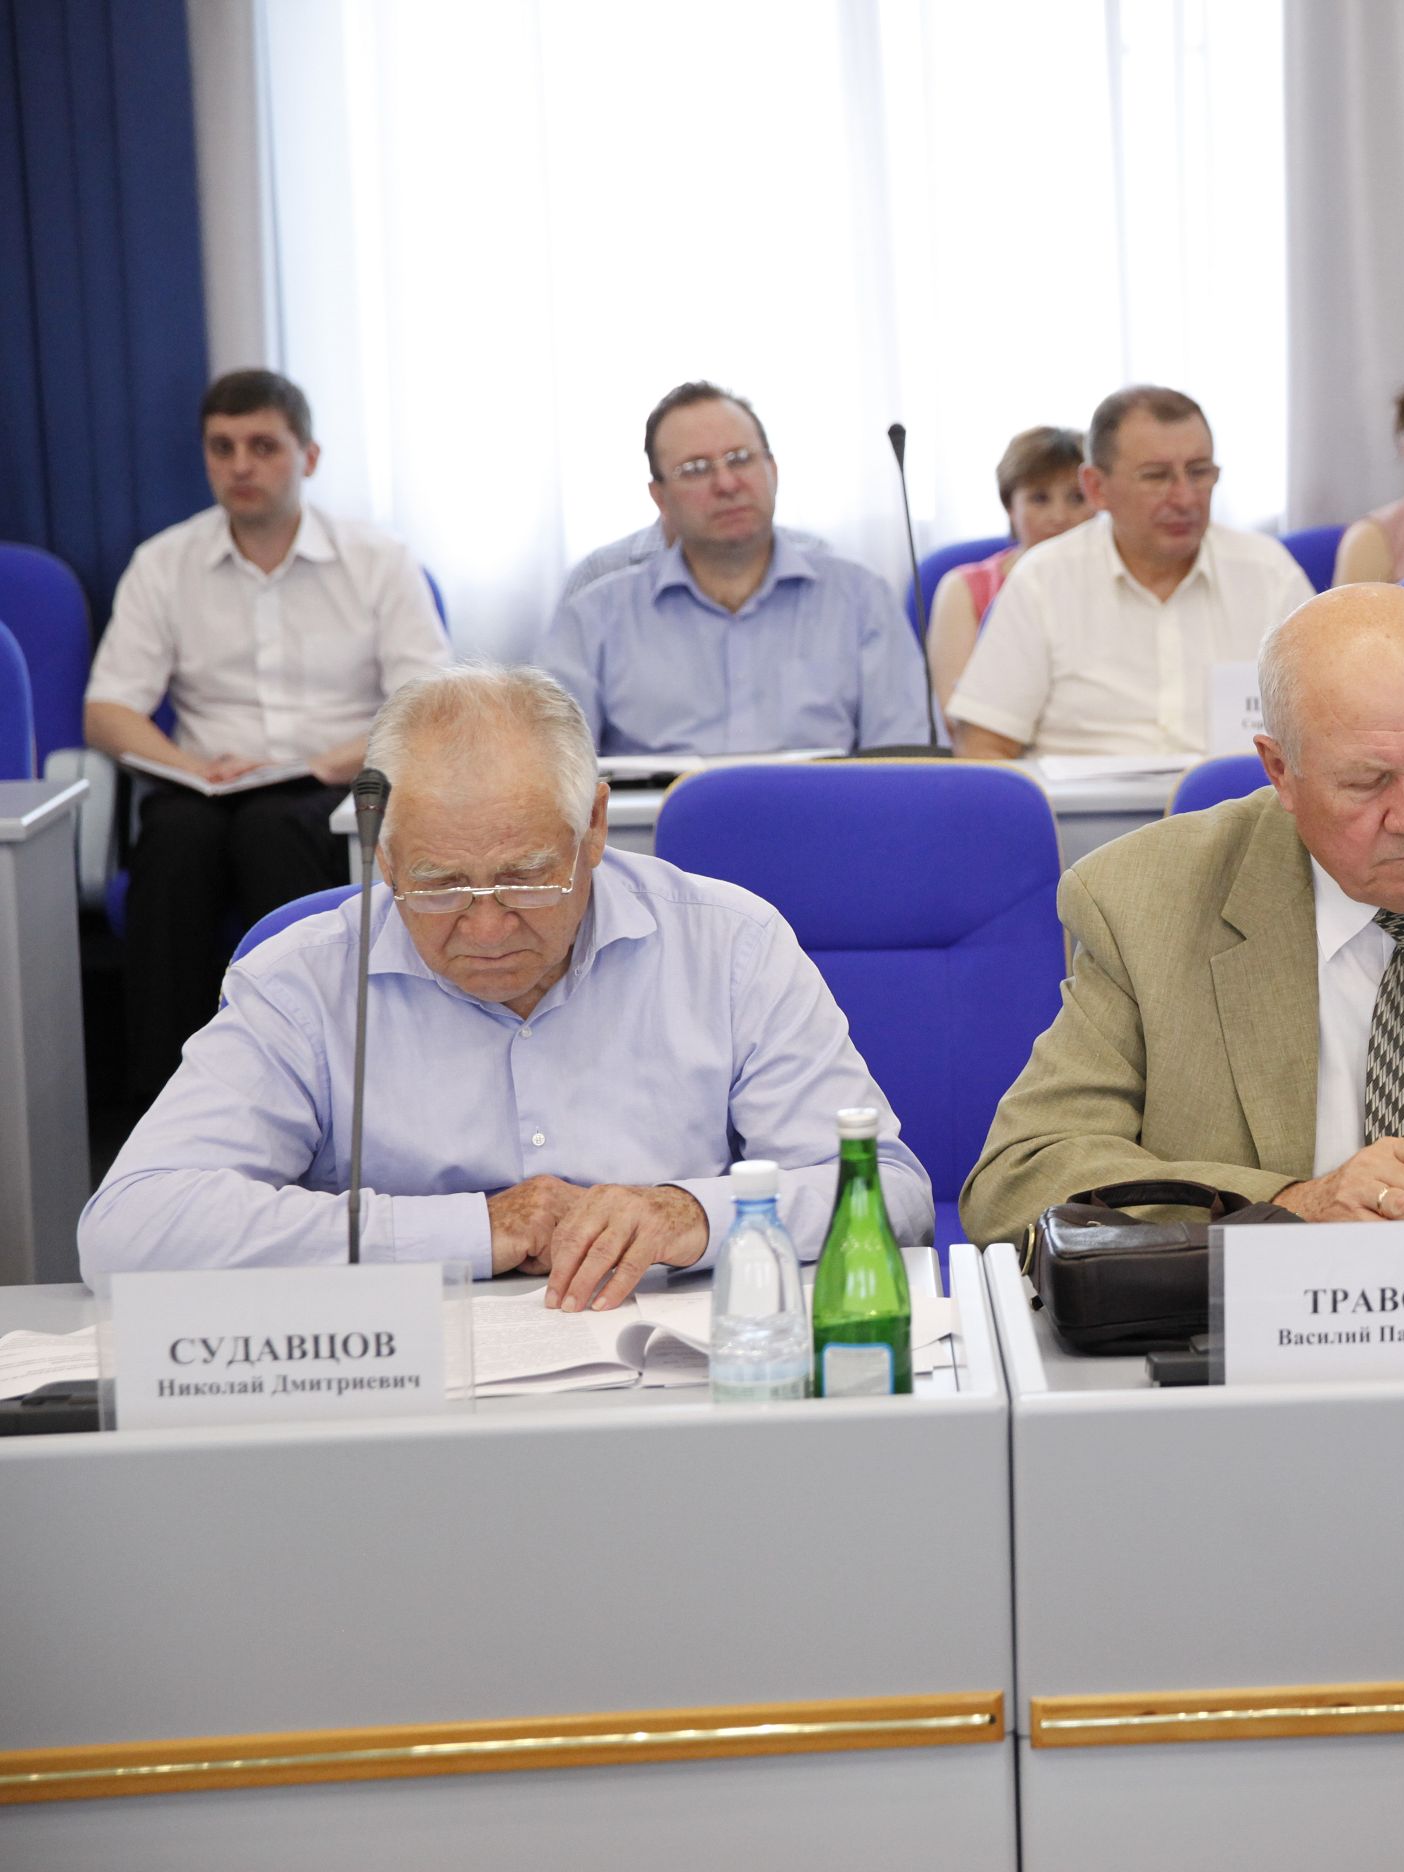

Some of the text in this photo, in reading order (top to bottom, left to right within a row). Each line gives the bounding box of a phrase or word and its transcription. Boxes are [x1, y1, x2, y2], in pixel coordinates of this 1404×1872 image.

[1277, 1325, 1371, 1346] Василий
[168, 1331, 396, 1366] СУДАВЦОВ
[157, 1373, 421, 1397] Николай Дмитриевич
